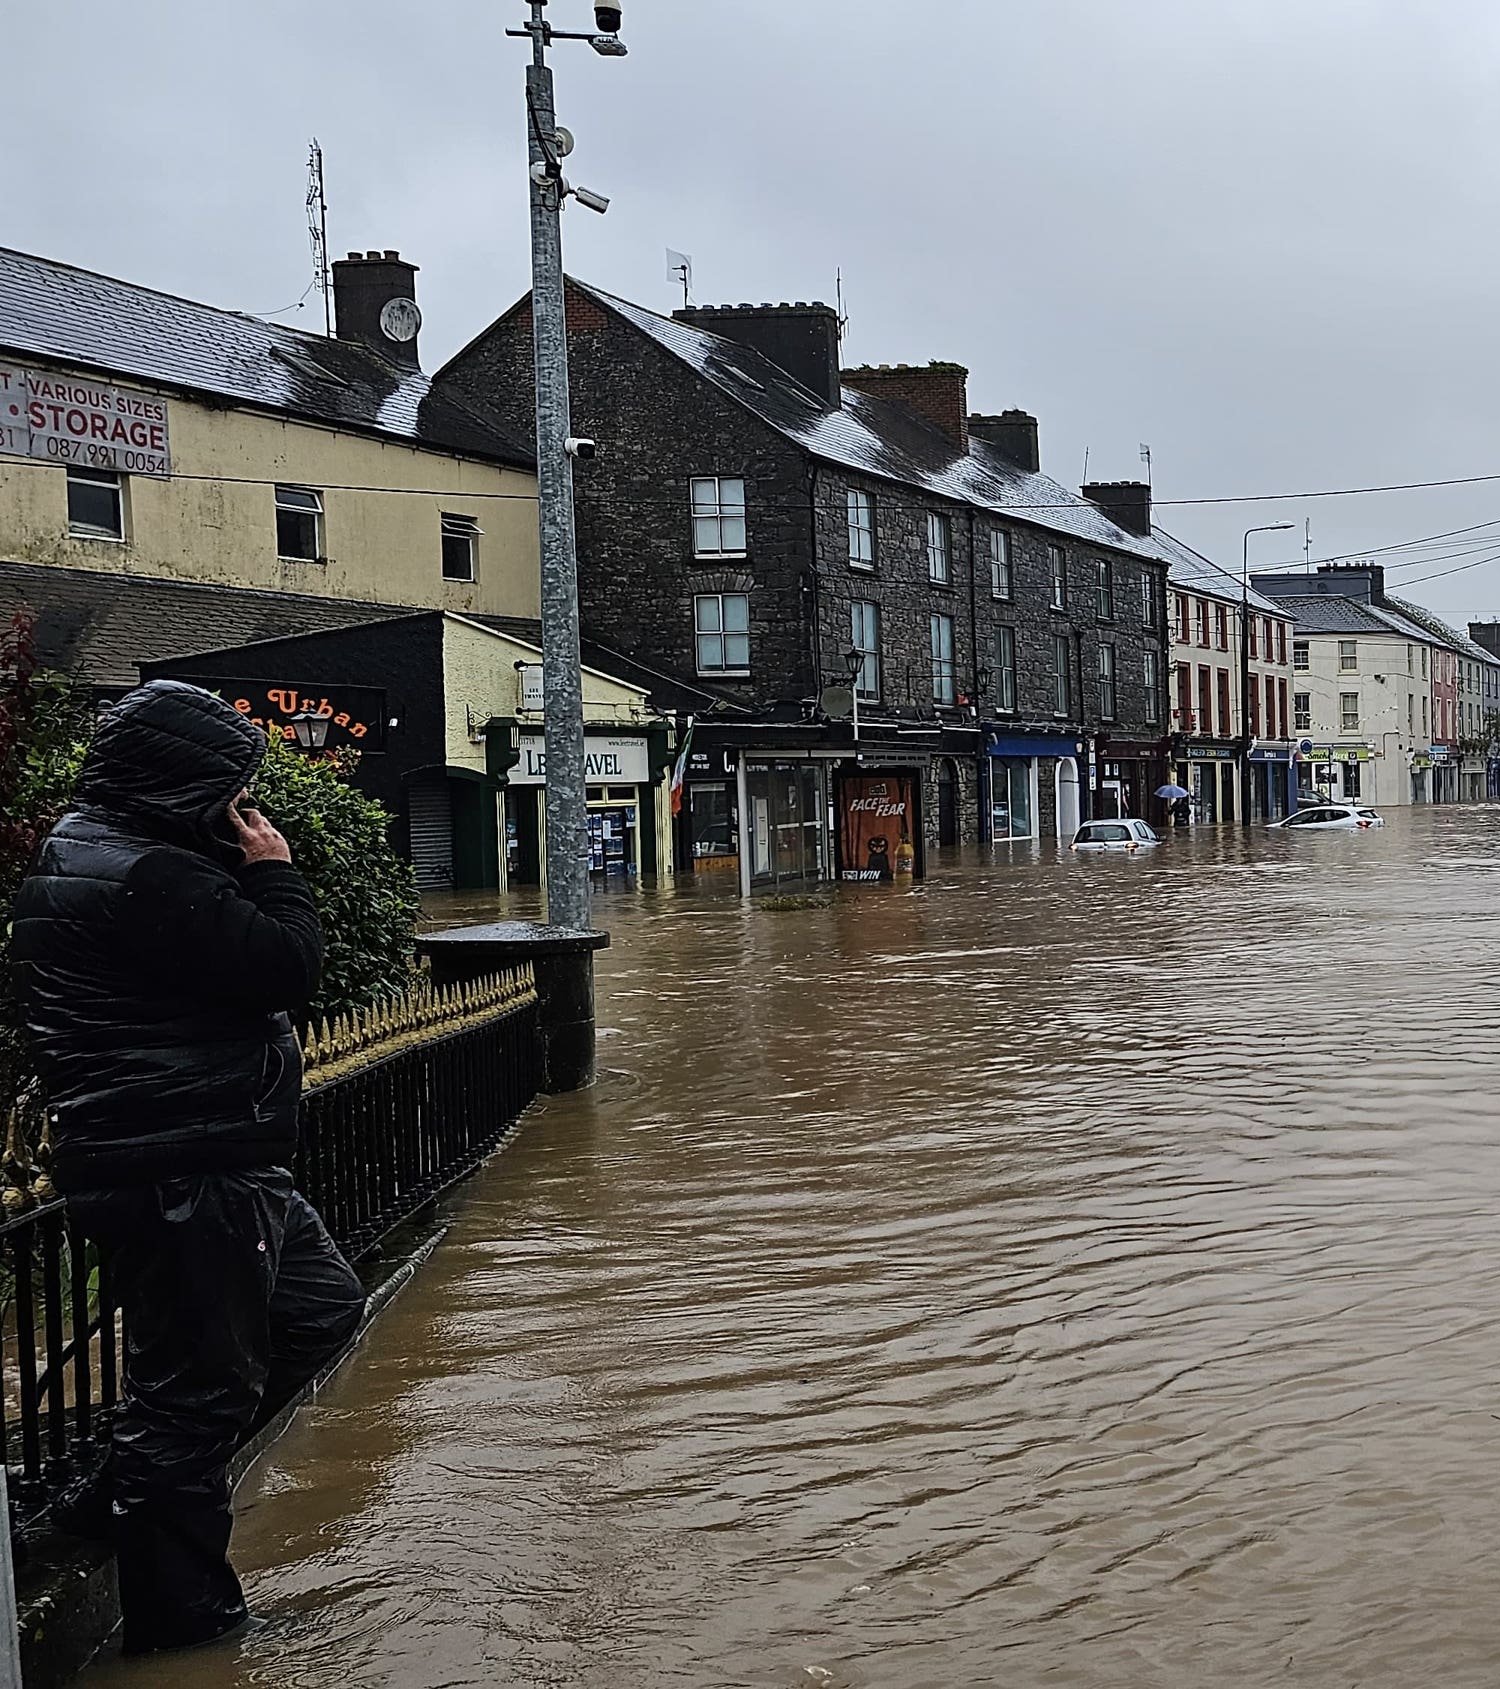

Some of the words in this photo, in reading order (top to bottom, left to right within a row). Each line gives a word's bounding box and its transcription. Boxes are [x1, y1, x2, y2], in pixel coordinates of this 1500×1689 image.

[28, 378, 111, 410] VARIOUS
[116, 397, 164, 421] SIZES
[29, 401, 165, 452] STORAGE
[47, 436, 81, 459] 087
[87, 443, 117, 464] 991
[125, 450, 165, 473] 0054
[267, 688, 368, 738] Urban
[850, 798, 878, 812] FACE
[875, 803, 905, 816] FEAR
[860, 870, 880, 880] WIN
